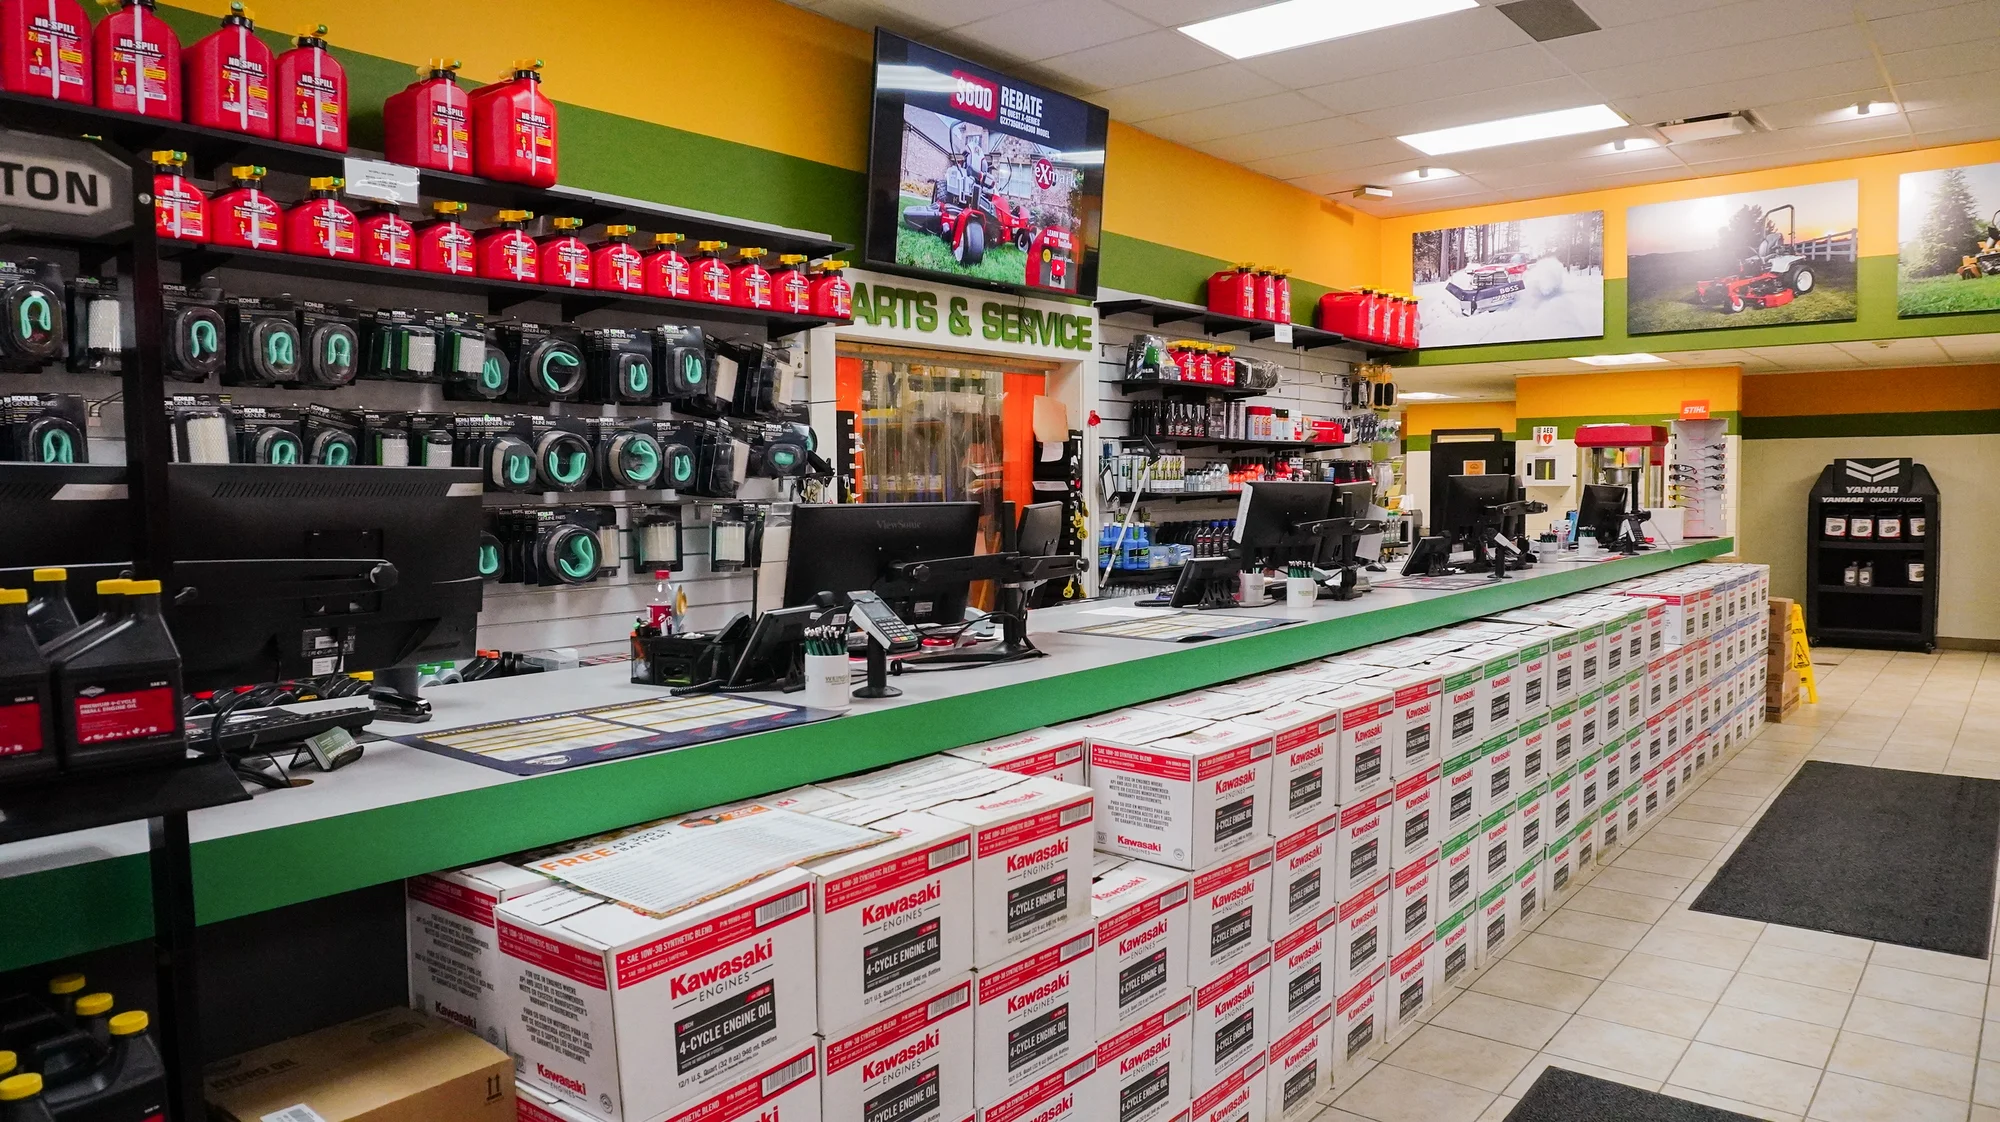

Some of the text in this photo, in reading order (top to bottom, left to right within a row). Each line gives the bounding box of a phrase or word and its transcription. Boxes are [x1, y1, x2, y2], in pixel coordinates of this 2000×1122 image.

[35, 17, 76, 35] NO-SPILL
[120, 38, 160, 53] NO-SPILL
[228, 57, 263, 72] NO-SPILL
[302, 74, 333, 89] NO-SPILL
[956, 77, 1043, 118] $600 REBATE
[437, 104, 464, 118] NO-SPILL
[521, 112, 546, 125] NO-SPILL
[0, 161, 98, 206] TON
[1500, 285, 1519, 294] BOSS
[850, 282, 1093, 352] ARTS & SERVICE
[310, 404, 330, 412] KOHLER
[1684, 406, 1706, 414] STIHL
[1845, 486, 1899, 494] YANMAR
[876, 520, 922, 529] ViewSonic
[1405, 701, 1431, 720] Kawasaki
[983, 735, 1041, 754] Kawasaki
[1354, 723, 1383, 743] Kawasaki
[1290, 743, 1324, 767] Kawasaki
[1215, 768, 1256, 794] Kawasaki
[976, 790, 1044, 812] Kawasaki
[1405, 787, 1431, 810] Kawasaki
[1351, 815, 1380, 839] Kawasaki
[620, 831, 672, 852] BATTERY
[1117, 835, 1162, 852] Kawasaki
[539, 848, 618, 871] FREE
[1006, 836, 1069, 874] Kawasaki
[1289, 844, 1323, 870] Kawasaki
[1023, 860, 1054, 879] ENGINES
[832, 883, 841, 893] SAE
[1093, 876, 1148, 902] Kawasaki
[1211, 879, 1255, 910] Kawasaki
[1405, 873, 1430, 897] Kawasaki
[861, 880, 941, 928] Kawasaki
[1009, 886, 1066, 918] 4-CYCLE ENGINE OIL
[1222, 898, 1244, 914] ENGINES
[883, 908, 922, 932] ENGINES
[1350, 903, 1379, 931] Kawasaki
[627, 949, 639, 964] SAE
[640, 943, 663, 959] 10W-30
[663, 931, 694, 951] SYNTHETIC
[695, 924, 713, 940] BLEND
[1119, 918, 1168, 956] Kawasaki
[1131, 940, 1156, 960] ENGINES
[866, 936, 938, 977] 4-CYCLE ENGINE OIL
[1288, 938, 1322, 969] Kawasaki
[669, 937, 773, 1000] Kawasaki
[1121, 964, 1165, 995] 4-CYCLE ENGINE OIL
[1400, 957, 1425, 983] Kawasaki
[699, 972, 750, 1002] ENGINES
[1007, 970, 1070, 1014] Kawasaki
[1214, 981, 1255, 1018] Kawasaki
[435, 1000, 478, 1030] Kawasaki
[1023, 996, 1055, 1018] ENGINES
[1348, 991, 1375, 1021] Kawasaki
[679, 1001, 773, 1056] 4-CYCLE ENGINE OIL
[1010, 1018, 1067, 1058] 4-CYCLE ENGINE OIL
[678, 1077, 690, 1089] 12/1
[691, 1070, 703, 1083] U.S.
[703, 1063, 718, 1076] Quart
[718, 1059, 727, 1070] (32
[761, 1035, 778, 1048] Bottles
[862, 1028, 940, 1084] Kawasaki
[1119, 1034, 1171, 1075] Kawasaki
[1284, 1035, 1319, 1070] Kawasaki
[537, 1063, 587, 1095] Kawasaki
[882, 1058, 922, 1085] ENGINES
[1132, 1056, 1159, 1077] ENGINES
[550, 1082, 576, 1099] ENGINES
[867, 1084, 937, 1122] 4-CYCLE ENGINE OIL
[1121, 1076, 1169, 1114] 4-CYCLE ENGINE OIL
[1209, 1087, 1250, 1122] Kawasaki
